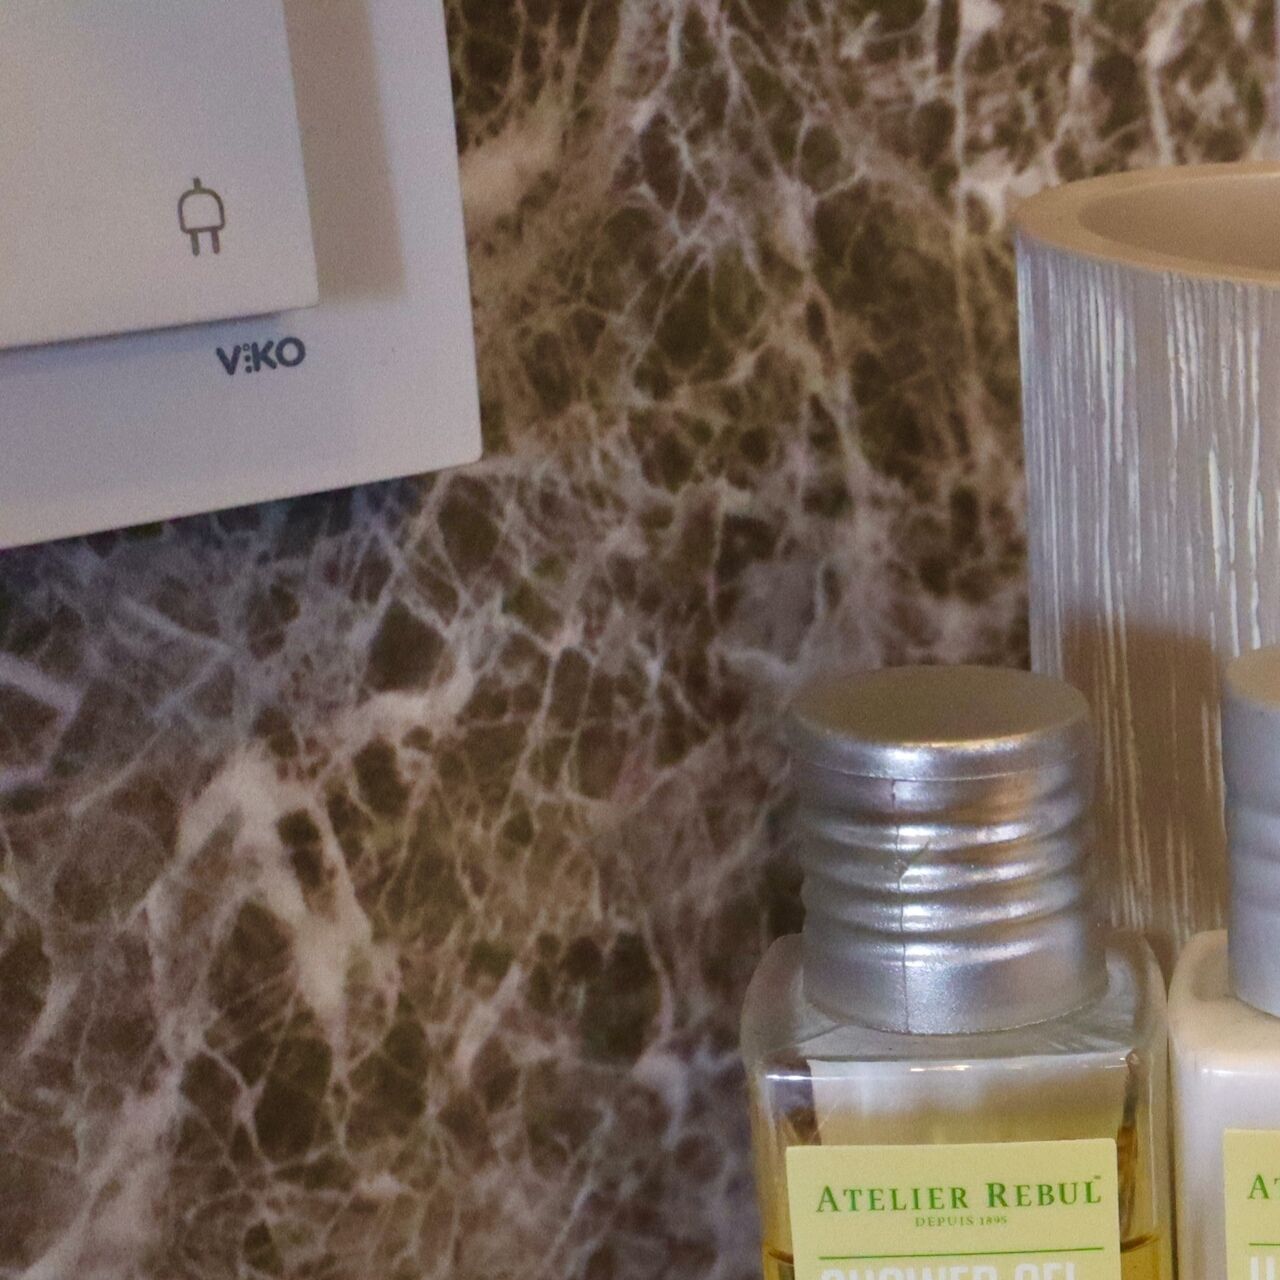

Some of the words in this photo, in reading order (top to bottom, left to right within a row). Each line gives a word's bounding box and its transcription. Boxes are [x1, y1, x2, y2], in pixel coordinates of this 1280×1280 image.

[816, 1185, 969, 1213] ATELIER
[915, 1215, 974, 1228] DEPUIS
[979, 1215, 1008, 1226] 1895
